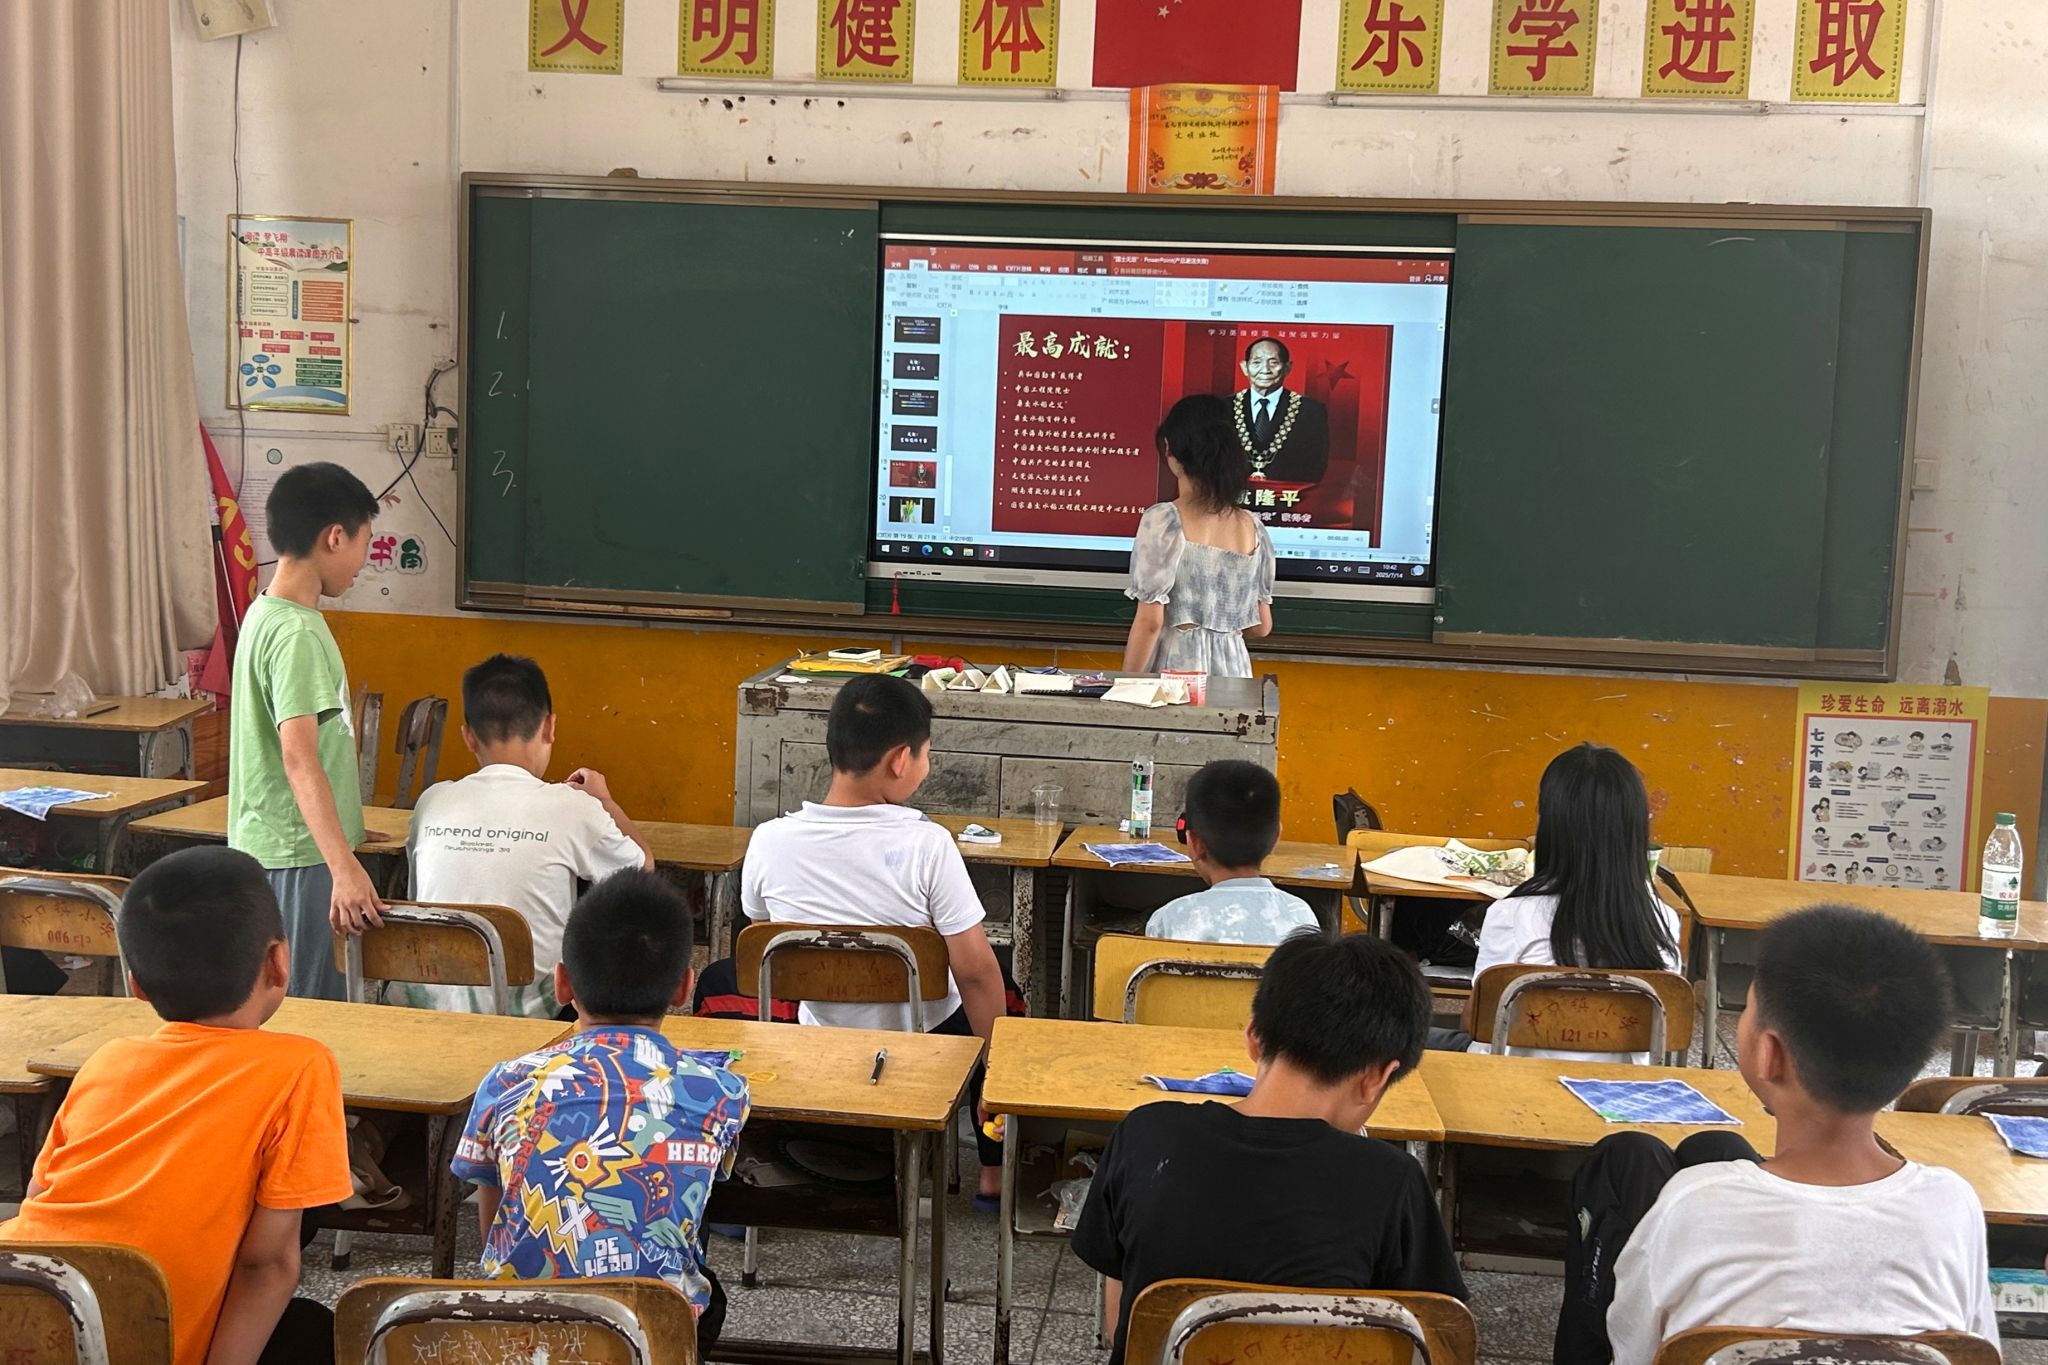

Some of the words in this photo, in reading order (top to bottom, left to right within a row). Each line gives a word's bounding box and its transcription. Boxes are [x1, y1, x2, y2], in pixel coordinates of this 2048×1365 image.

[691, 0, 757, 66] 明
[831, 0, 900, 68] 健
[972, 0, 1045, 74] 体
[1353, 0, 1423, 77] 乐
[1507, 0, 1577, 81] 学
[1661, 0, 1735, 83] 进
[1810, 0, 1885, 86] 取
[1015, 384, 1070, 394] 中国工程院院士
[1013, 414, 1076, 424] 杂交水稻育种专家
[1012, 444, 1140, 456] 中国杂交水稻事业的开创者和领导者
[1012, 458, 1091, 468] 中国共产党的亲密朋友
[1012, 473, 1090, 483] 无党派人士的杰出代表
[1010, 487, 1082, 497] 湖南省政协原副主席
[1821, 694, 1886, 713] 珍爱生命
[1899, 696, 1964, 716] 远离溺水
[1808, 728, 1825, 789] 七不两会
[487, 828, 549, 842] original
[667, 1142, 719, 1164] HERO
[584, 1253, 633, 1277] HERO
